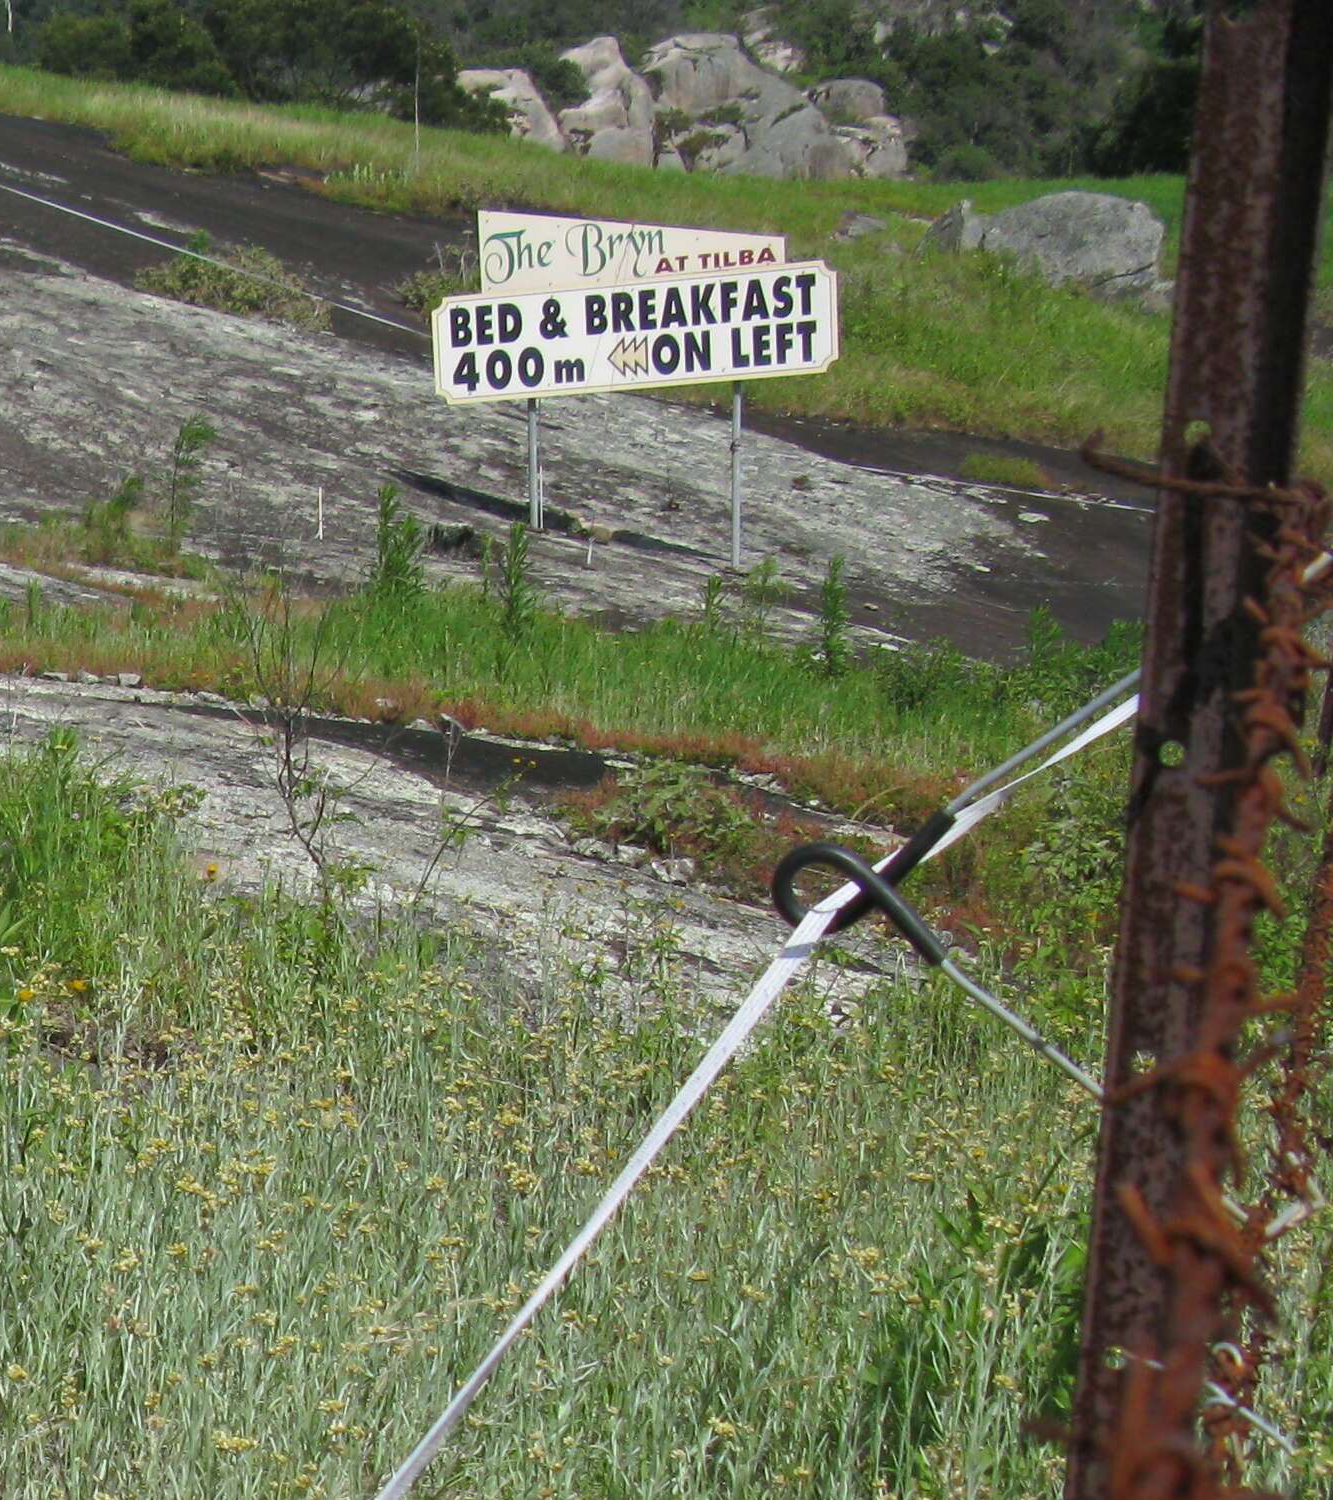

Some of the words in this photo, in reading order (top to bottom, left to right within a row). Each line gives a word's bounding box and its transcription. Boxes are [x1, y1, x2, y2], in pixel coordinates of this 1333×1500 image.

[484, 229, 553, 284] The
[565, 223, 666, 278] Bryn
[654, 255, 688, 275] AT
[698, 247, 776, 272] TILBA
[449, 303, 523, 348] BED
[539, 298, 569, 340] &
[584, 273, 817, 335] BREAKFAST
[453, 347, 545, 392] 400
[554, 356, 585, 384] m
[652, 330, 711, 375] ON
[731, 320, 817, 369] LEFT
